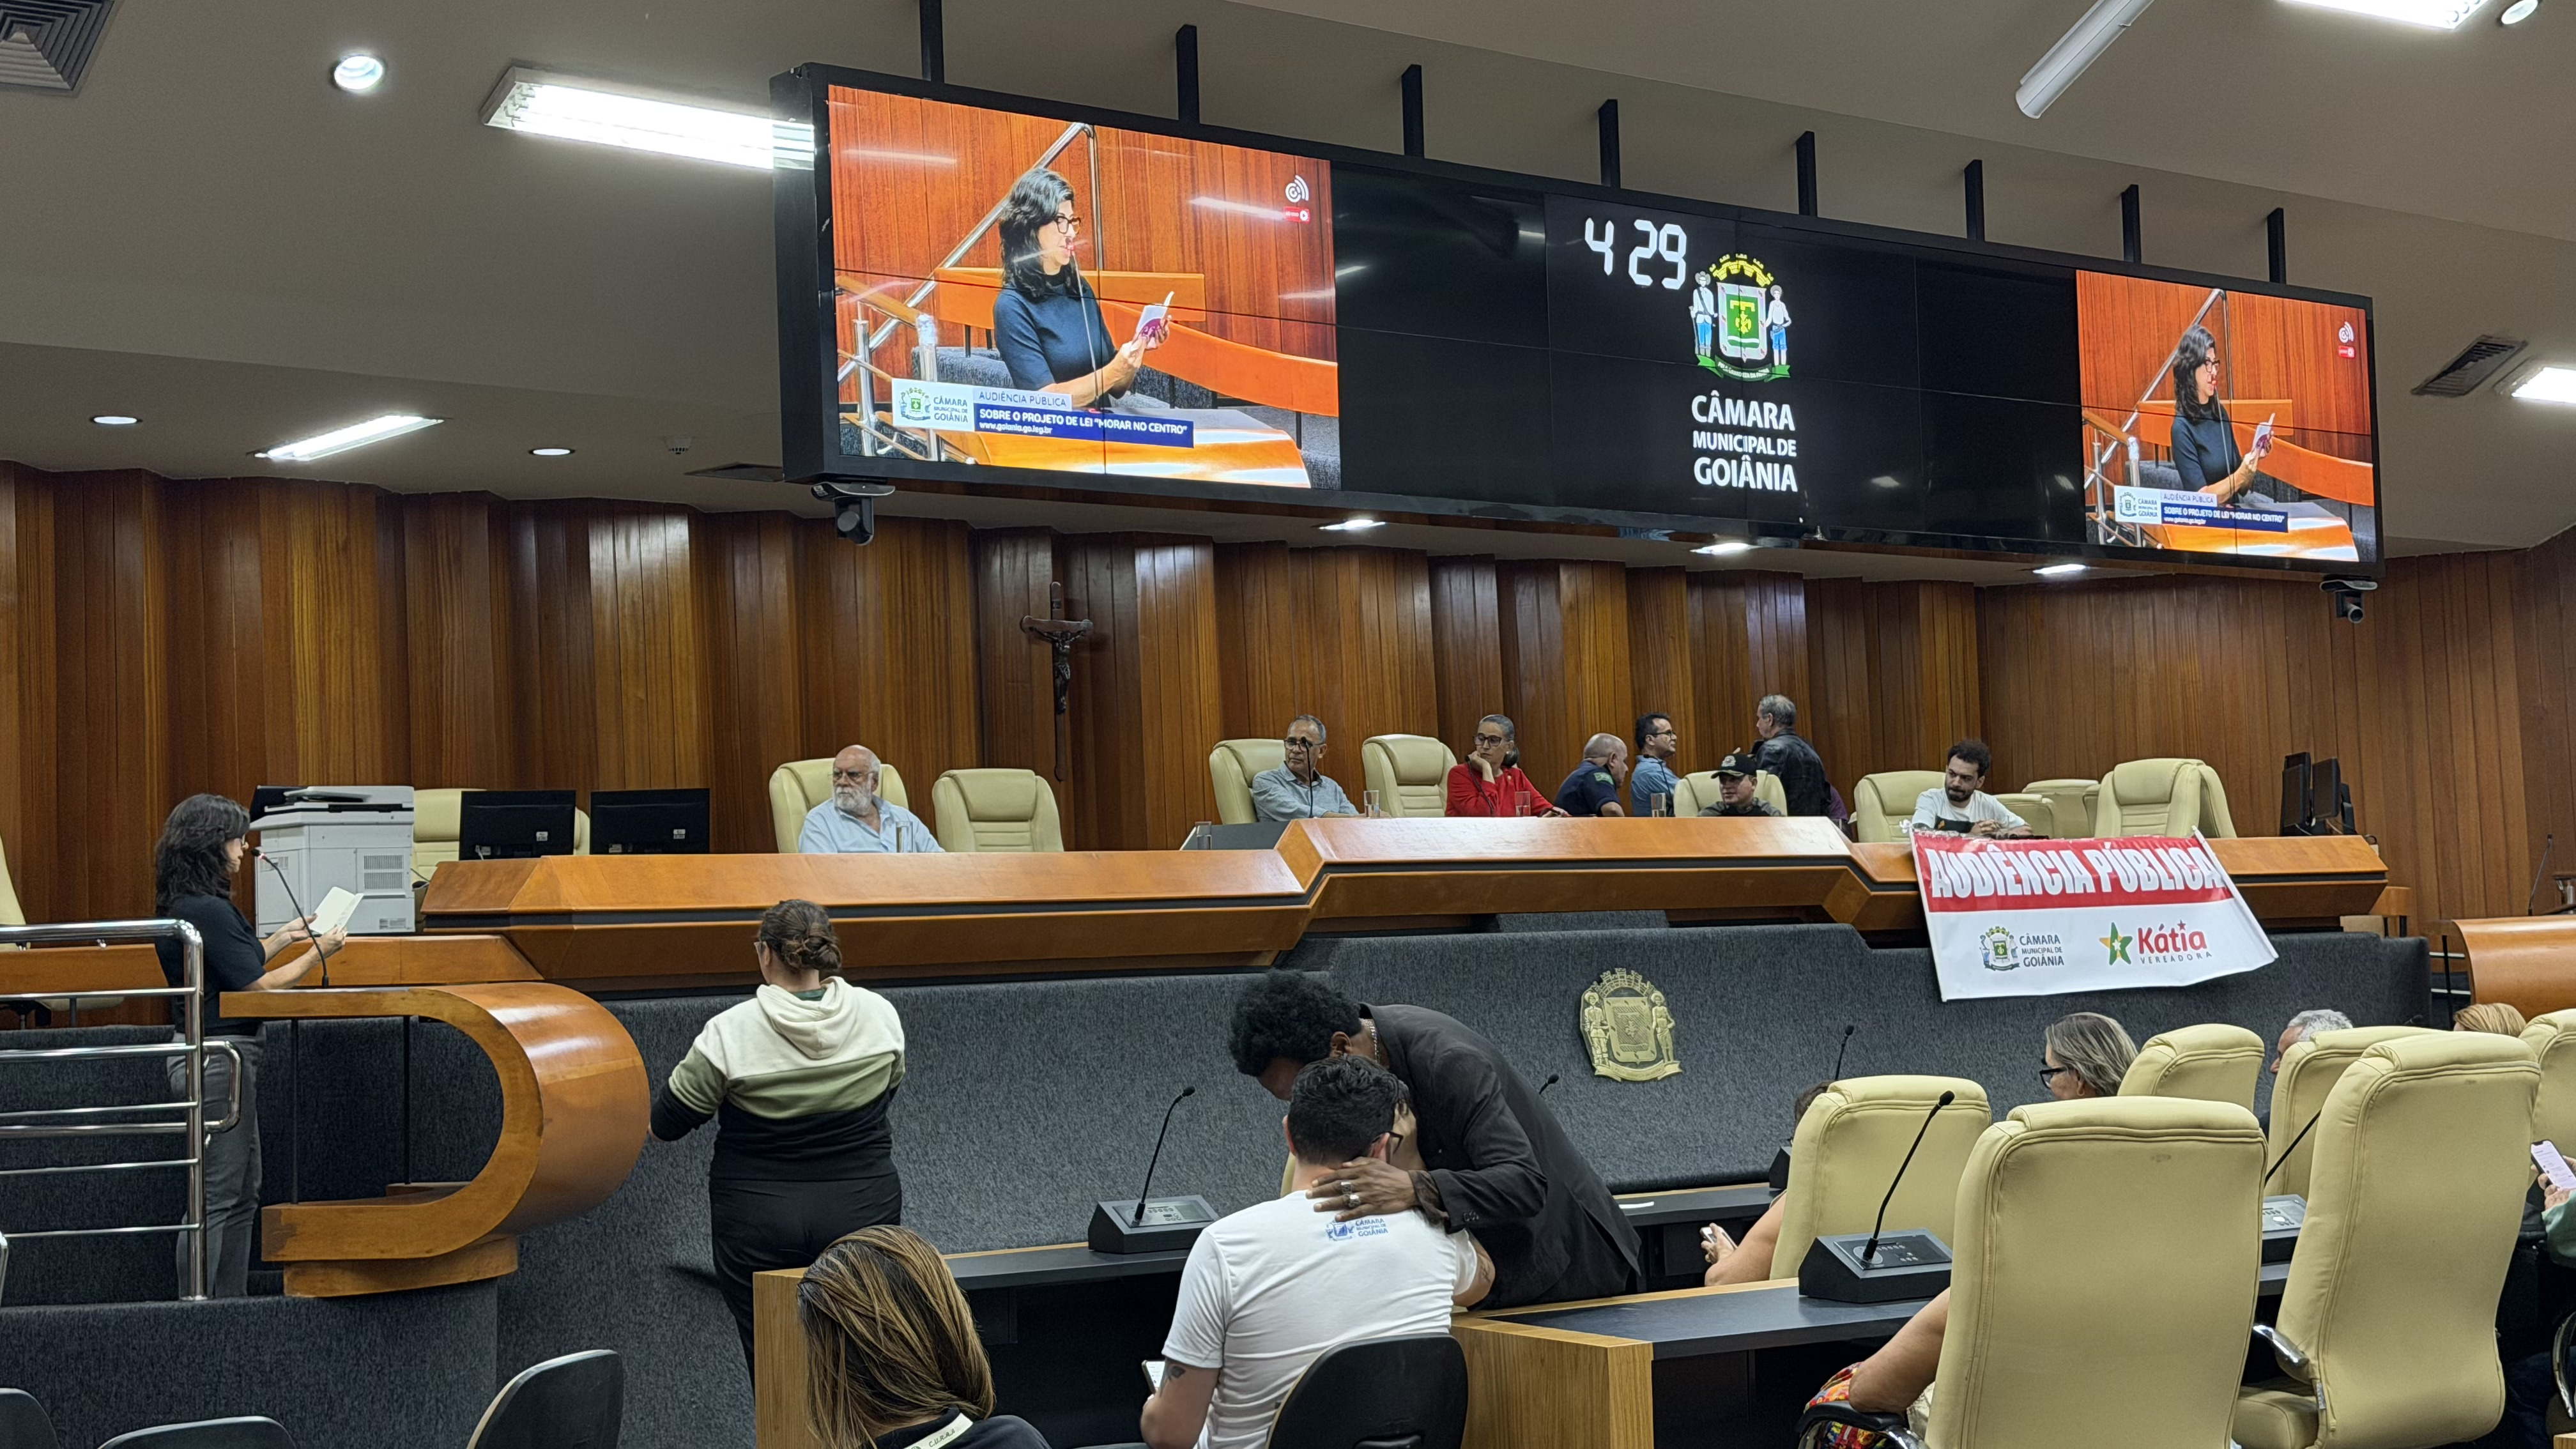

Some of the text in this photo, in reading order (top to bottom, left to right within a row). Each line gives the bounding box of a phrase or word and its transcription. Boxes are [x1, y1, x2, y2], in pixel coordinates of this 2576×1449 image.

[1584, 217, 1687, 289] 4 29
[933, 395, 968, 407] CÂMARA
[979, 390, 1066, 407] AUDIÊNCIA PÚBLICA
[933, 413, 969, 422] GOIÂNIA
[979, 408, 1188, 434] SOBRE O PROJETO DE LEI "MORAR NO CENTRO"
[1691, 390, 1796, 431] CÂMARA
[1692, 431, 1797, 457] MUNICIPAL DE
[1694, 454, 1798, 492] GOIÂNIA
[1924, 841, 2225, 898] AUDIÊNCIA PÚBLICA
[2019, 932, 2061, 947] CÂMARA
[2137, 921, 2208, 955] Kátia
[2023, 953, 2065, 968] GOIÂNIA
[2140, 951, 2212, 965] VEREADORA
[1358, 1228, 1388, 1236] GOIÂNIA
